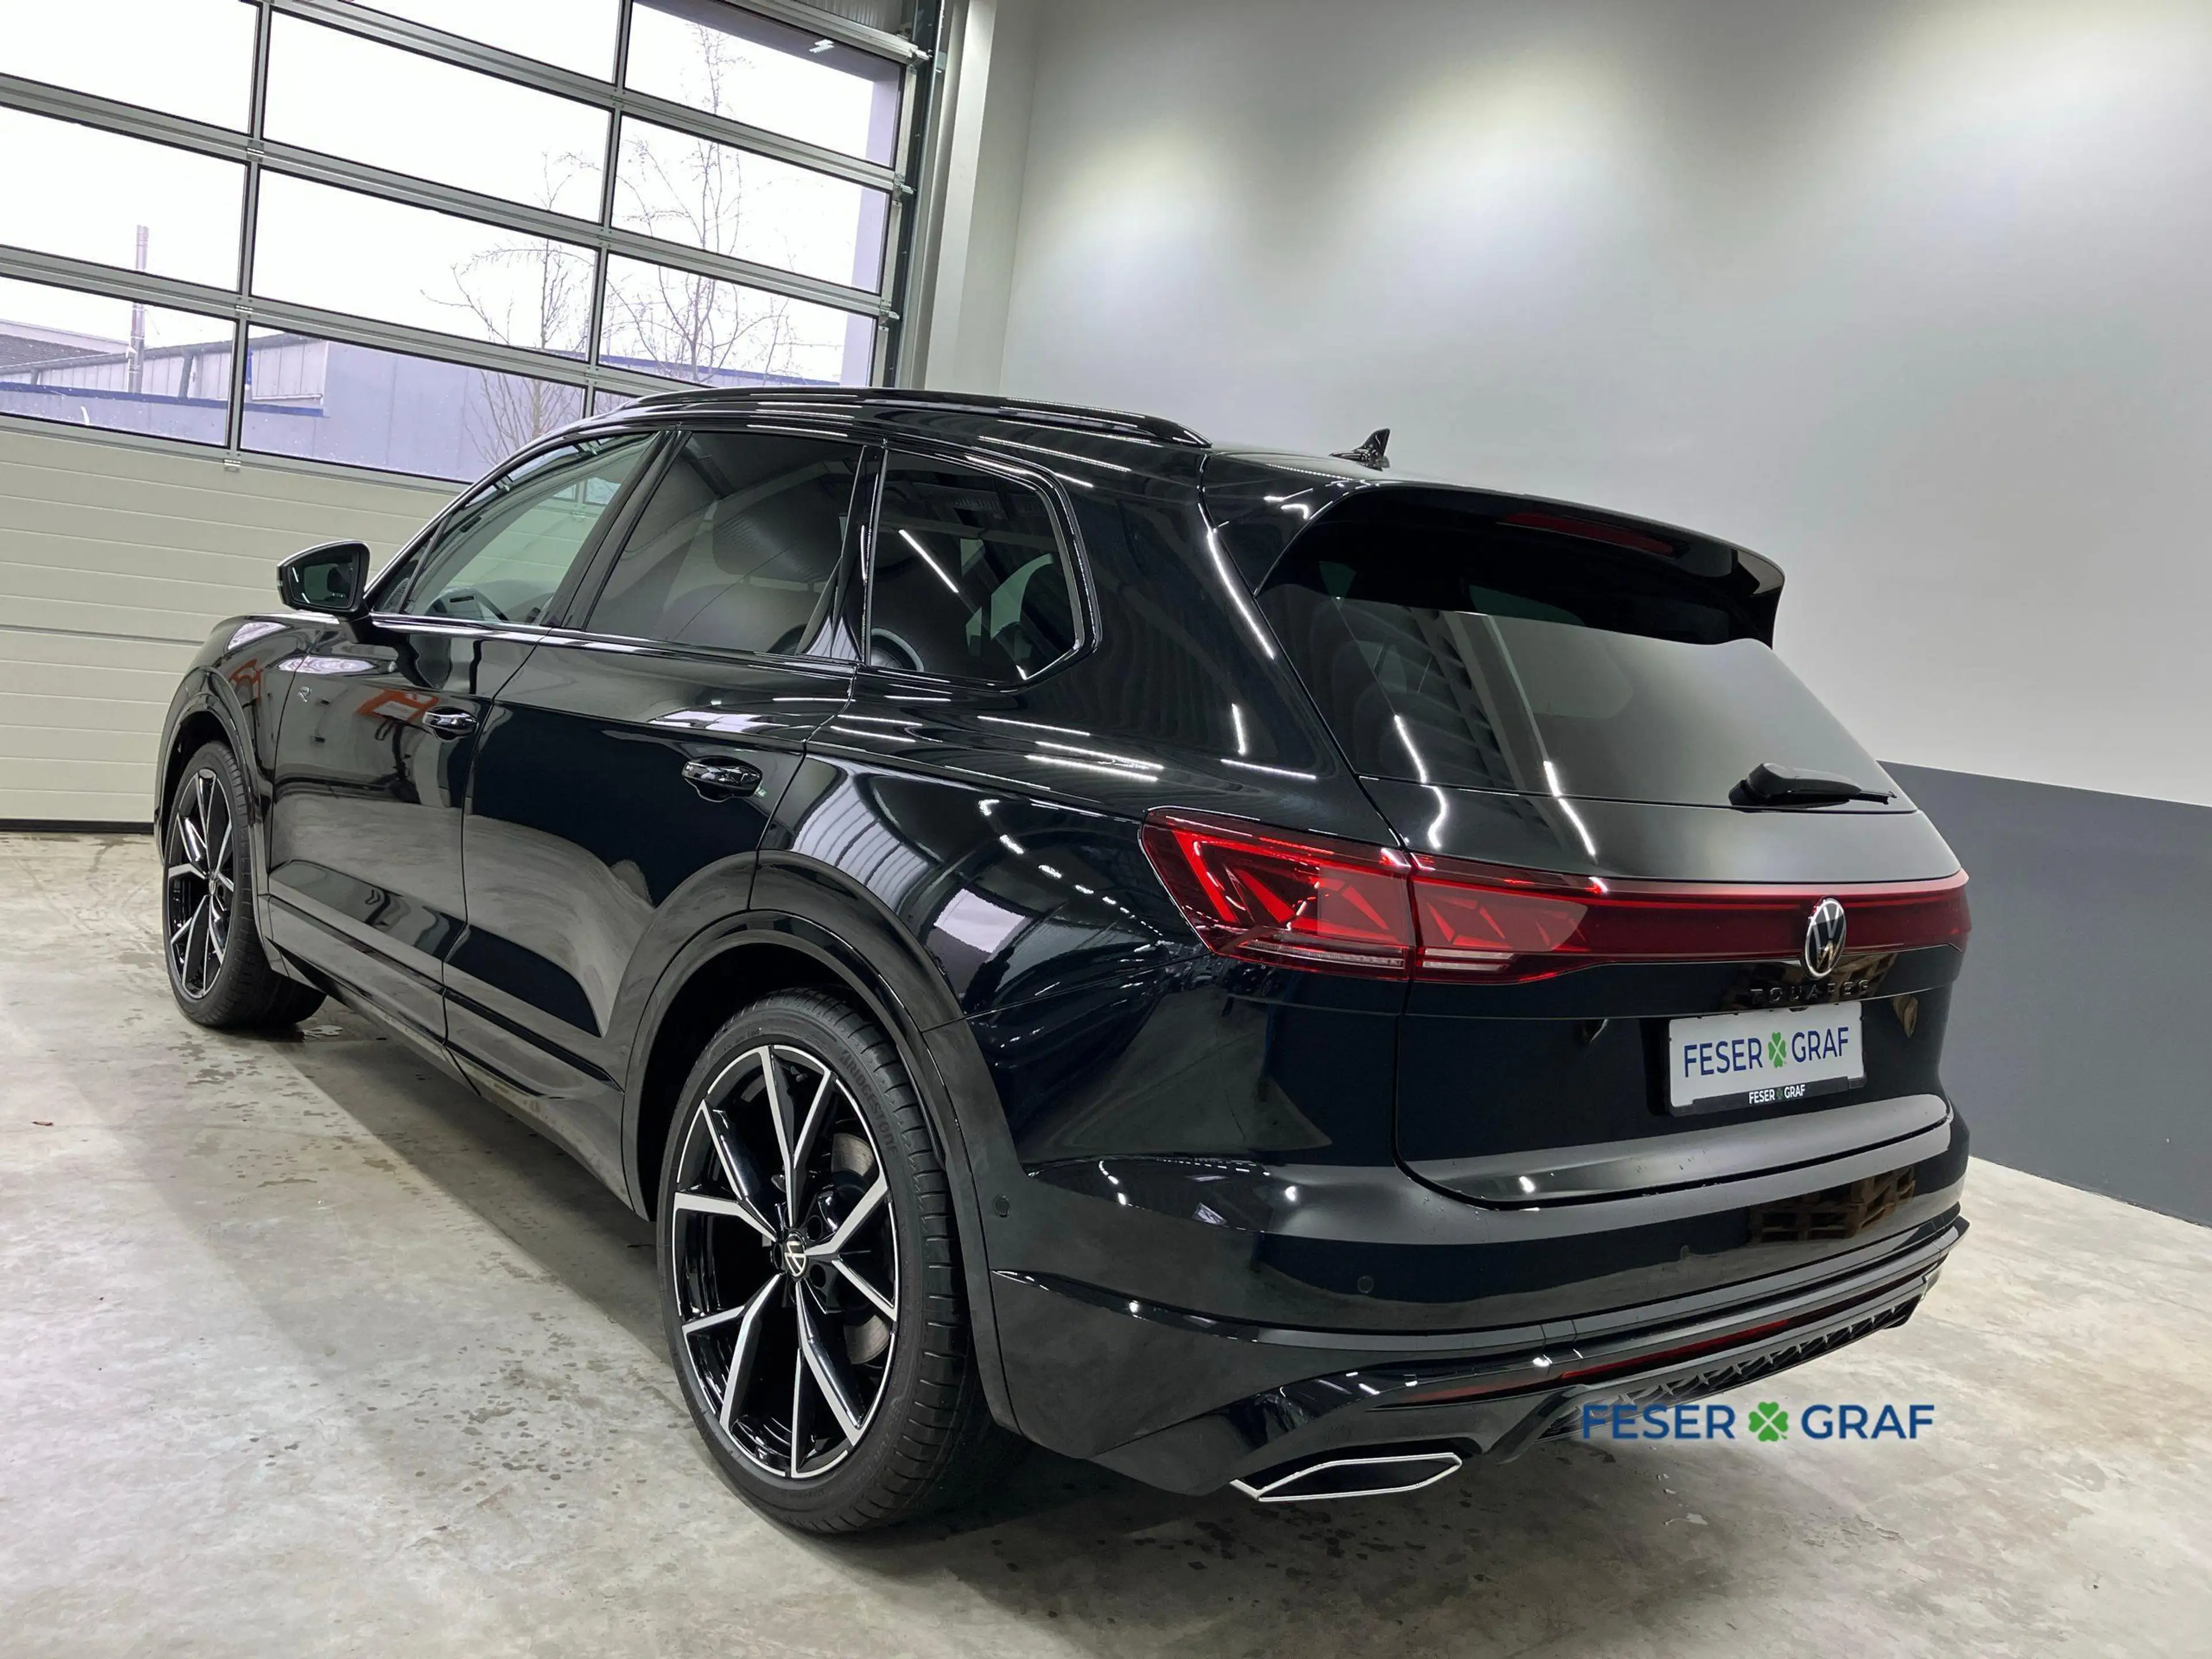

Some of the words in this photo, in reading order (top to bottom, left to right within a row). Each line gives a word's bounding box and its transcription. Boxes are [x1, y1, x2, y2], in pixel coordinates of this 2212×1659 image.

[1684, 1037, 1763, 1078] FESER
[1791, 1027, 1849, 1063] GRAF
[1748, 1089, 1775, 1104] FESER
[1784, 1084, 1805, 1099] GRAF
